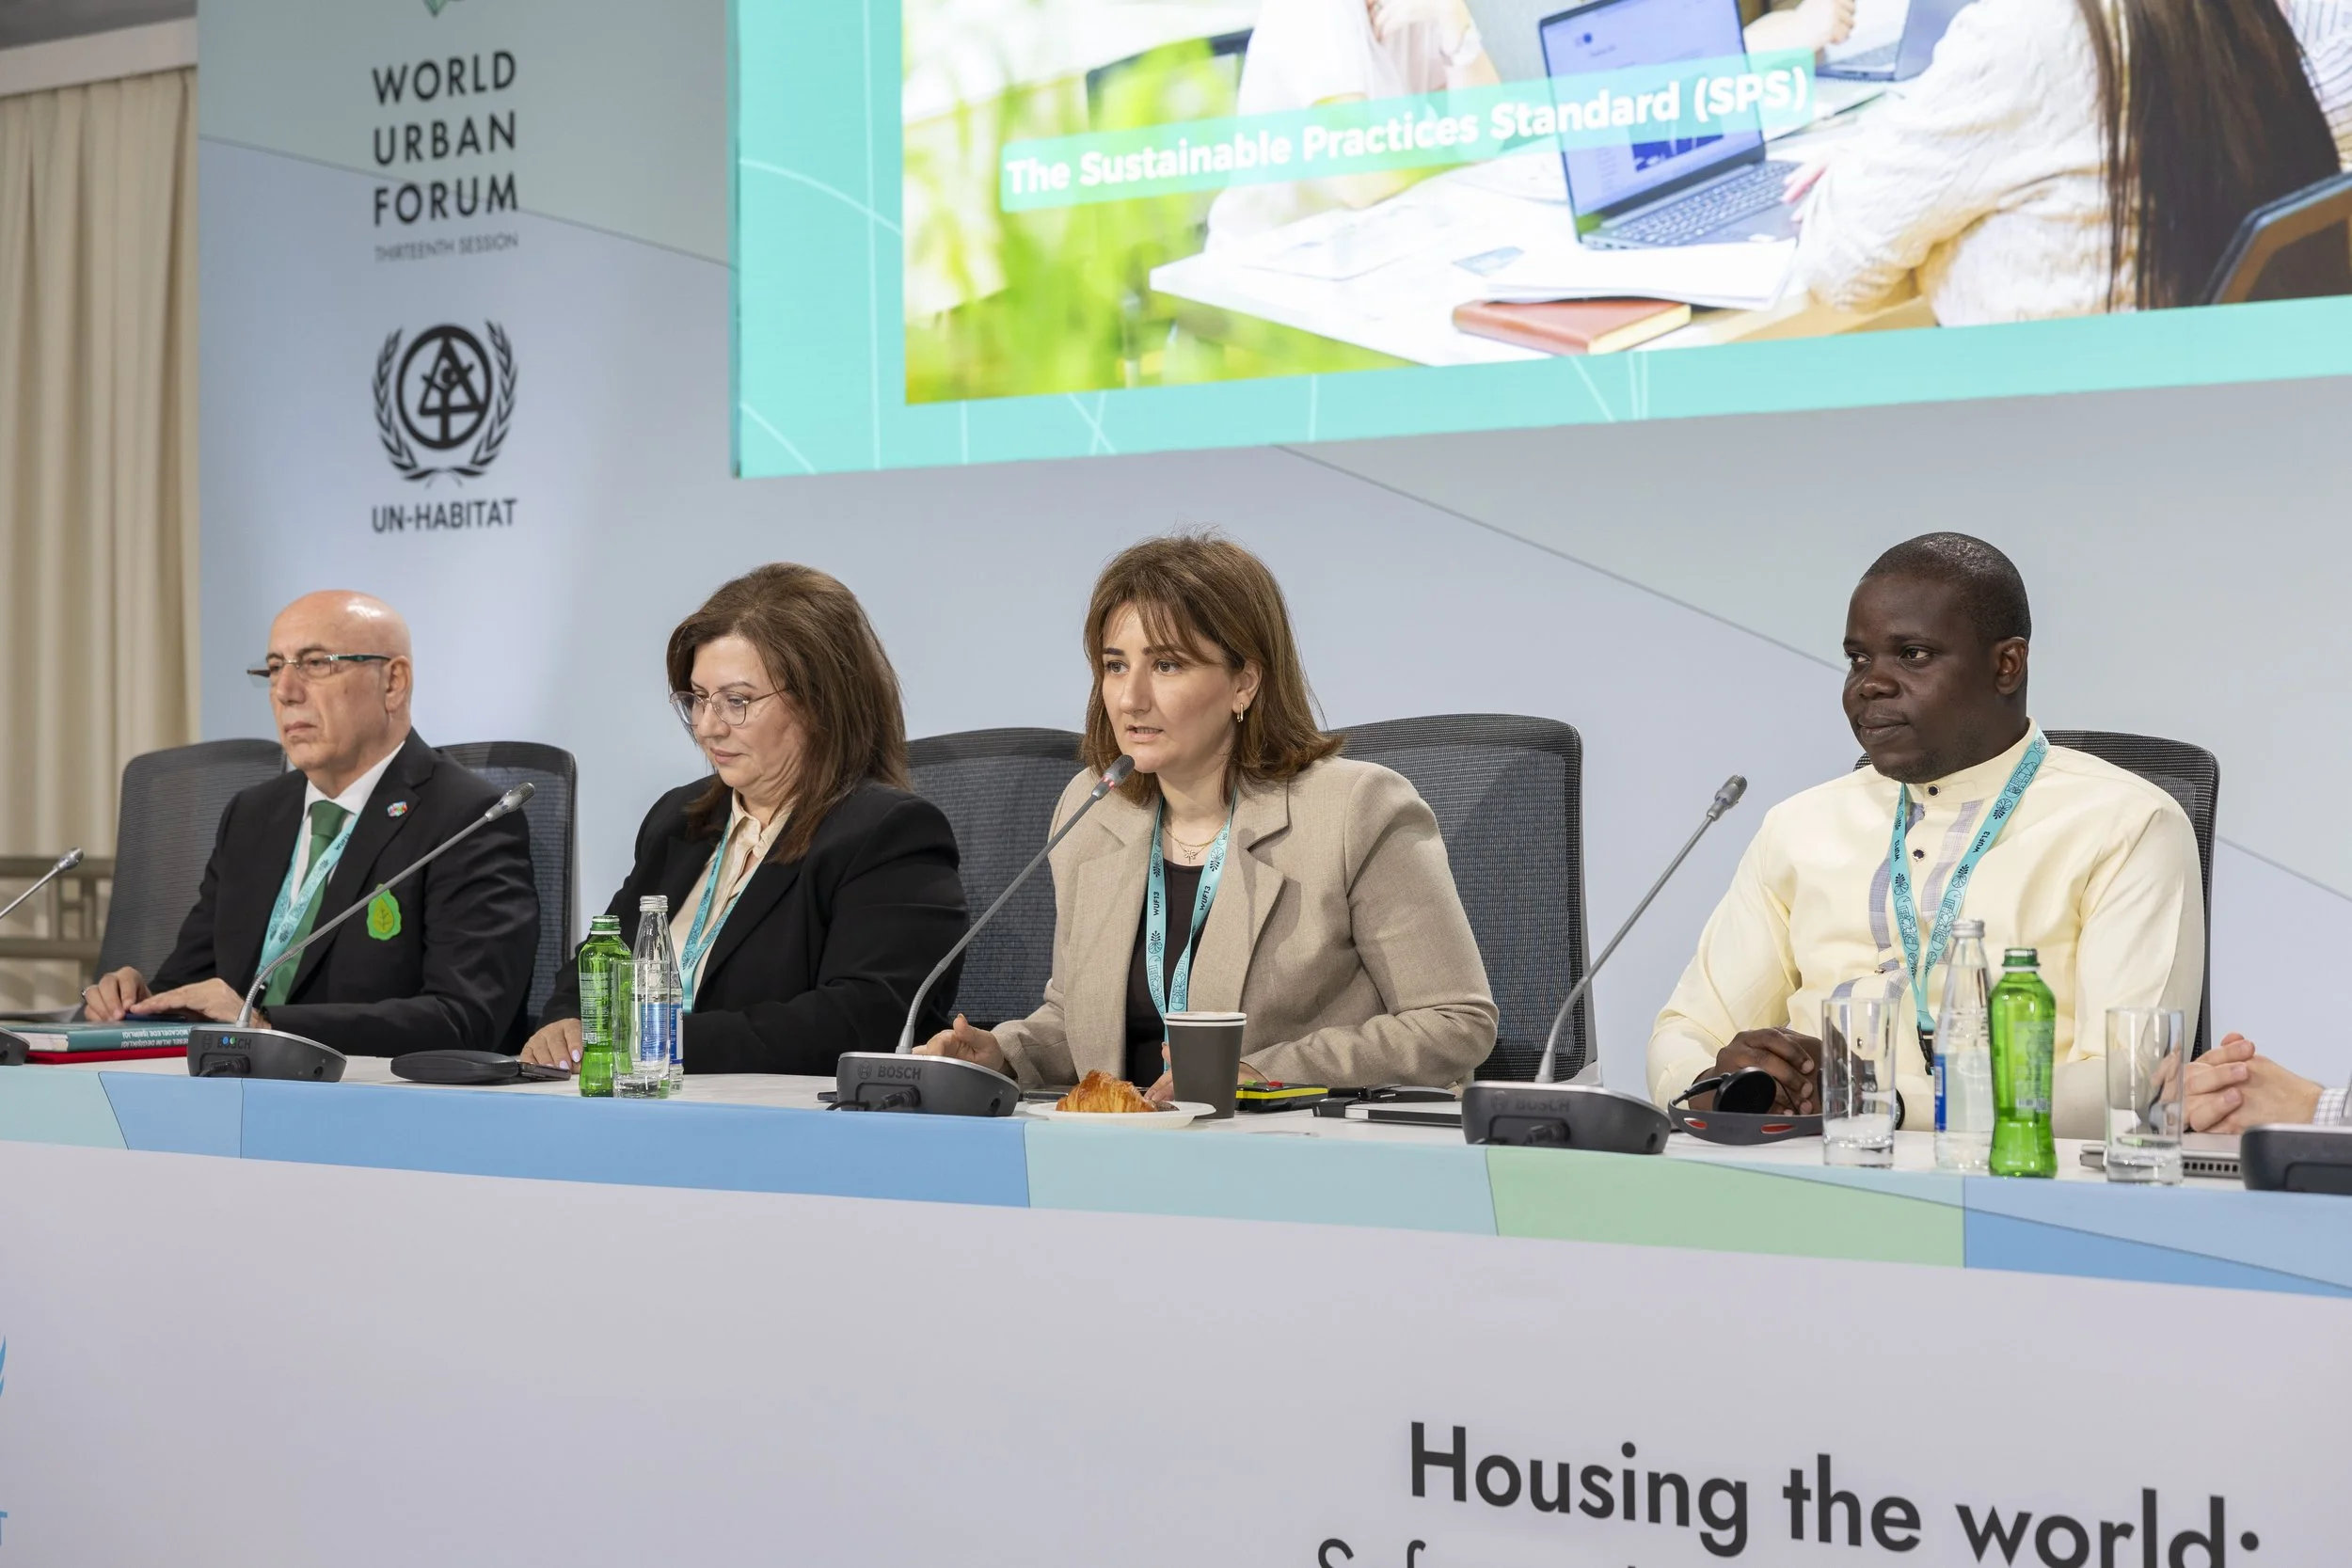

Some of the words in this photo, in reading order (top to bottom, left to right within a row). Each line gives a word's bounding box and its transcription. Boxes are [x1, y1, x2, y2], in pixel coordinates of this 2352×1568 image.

[372, 50, 516, 105] WORLD
[373, 111, 516, 166] URBAN
[1005, 156, 1071, 195] The
[1078, 130, 1293, 187] Sustainable
[1302, 112, 1480, 162] Practices
[1489, 81, 1680, 141] Standard
[1694, 65, 1808, 124] (SPS)
[373, 173, 518, 227] FORUM
[375, 239, 454, 262] THIRTEENTH
[458, 232, 518, 255] SESSION
[373, 499, 516, 533] UN-HABITAT
[1972, 831, 1991, 853] WUF13
[1199, 885, 1212, 911] WUF13
[878, 1065, 922, 1081] BOSCH
[1407, 1421, 1748, 1559] Housing
[1782, 1453, 1922, 1553] the
